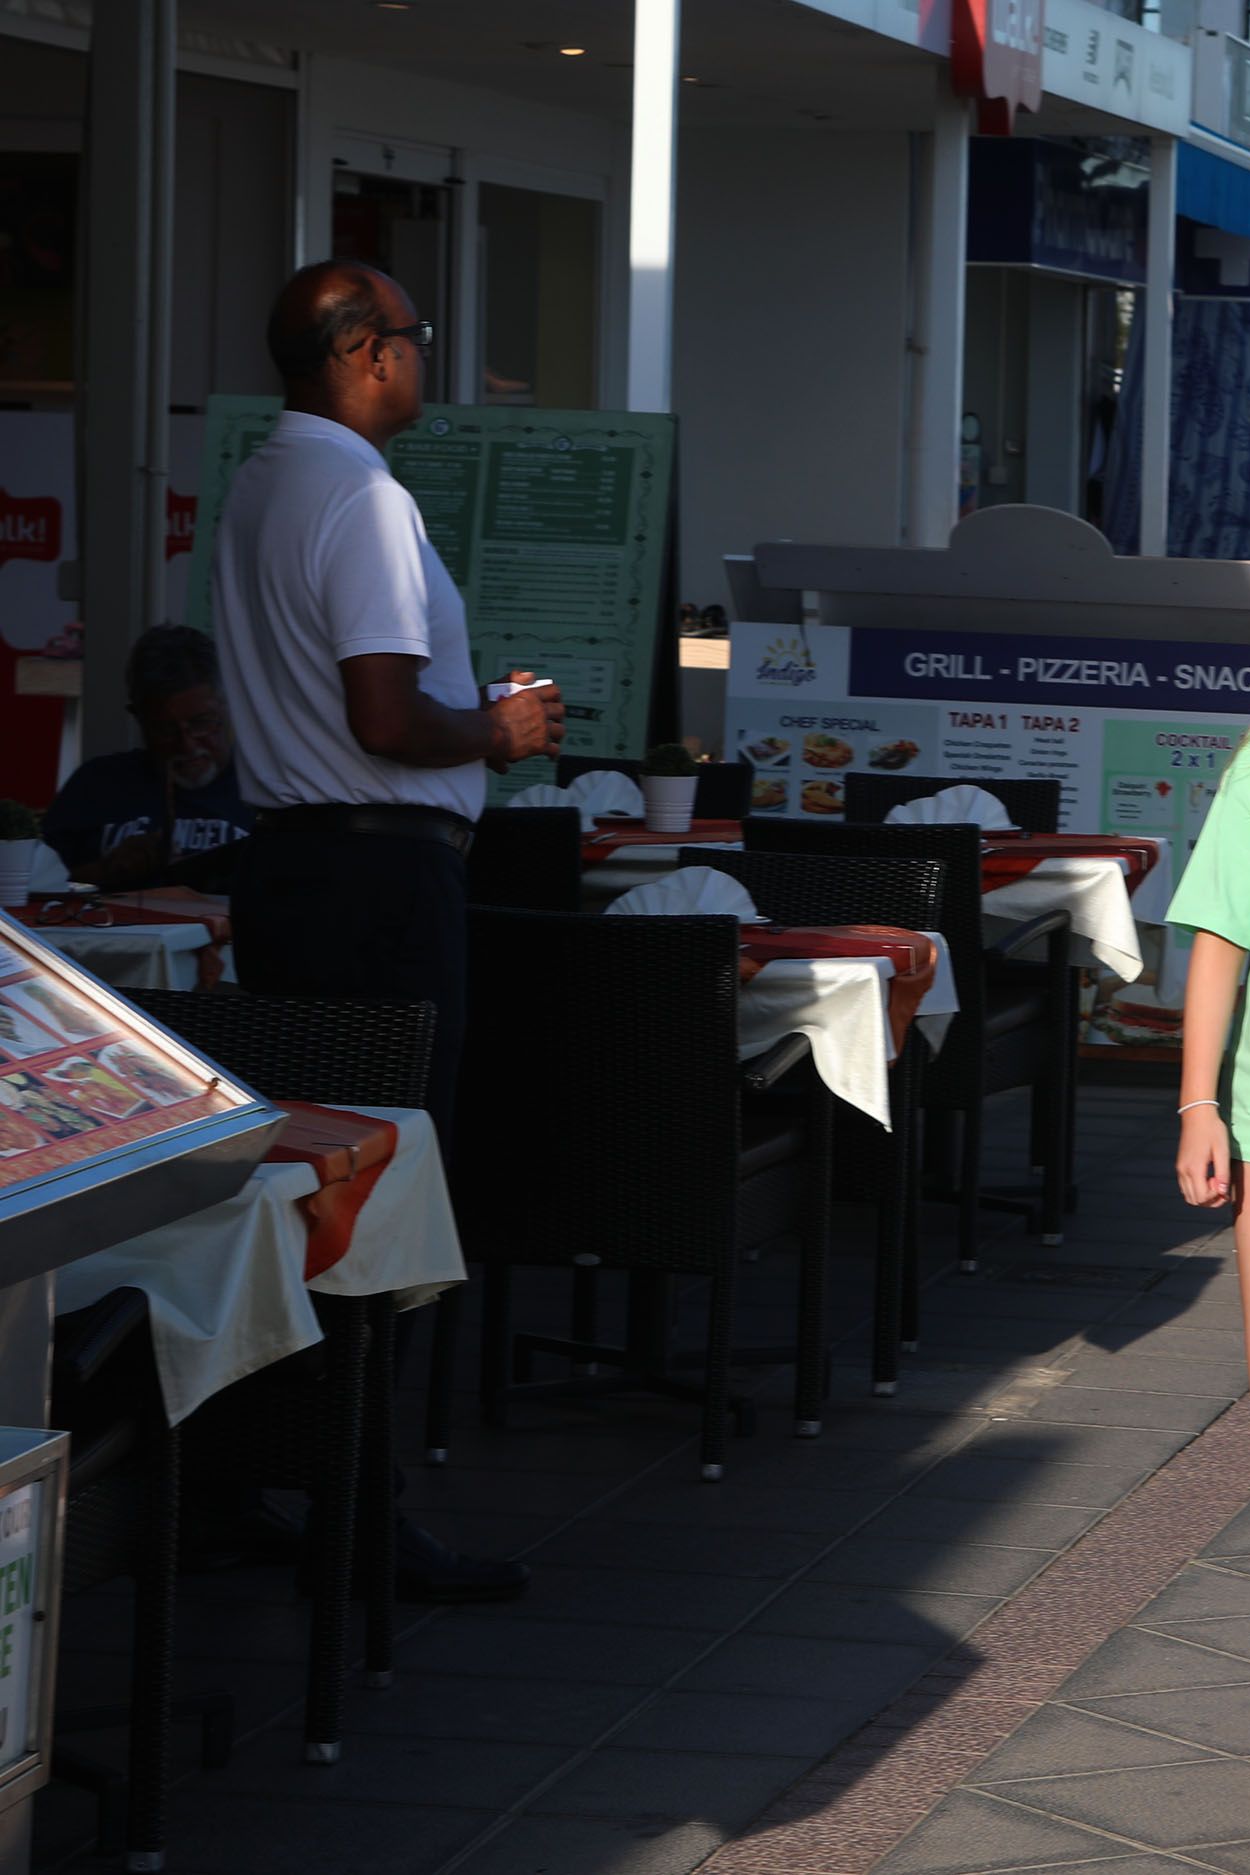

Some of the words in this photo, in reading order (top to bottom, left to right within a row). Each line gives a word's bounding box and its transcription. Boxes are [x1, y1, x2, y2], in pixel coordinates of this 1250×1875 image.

[905, 652, 992, 681] GRILL
[1018, 656, 1151, 688] PIZZERIA
[779, 715, 818, 729] CHEF
[820, 716, 881, 732] SPECIAL
[948, 711, 995, 730] TAPA
[998, 715, 1008, 730] 1
[1021, 715, 1066, 732] TAPA
[1068, 718, 1081, 733] 2
[1155, 733, 1233, 750] COCKTAIL
[1170, 750, 1182, 767] 2
[1187, 754, 1200, 768] x
[1206, 753, 1216, 768] 1
